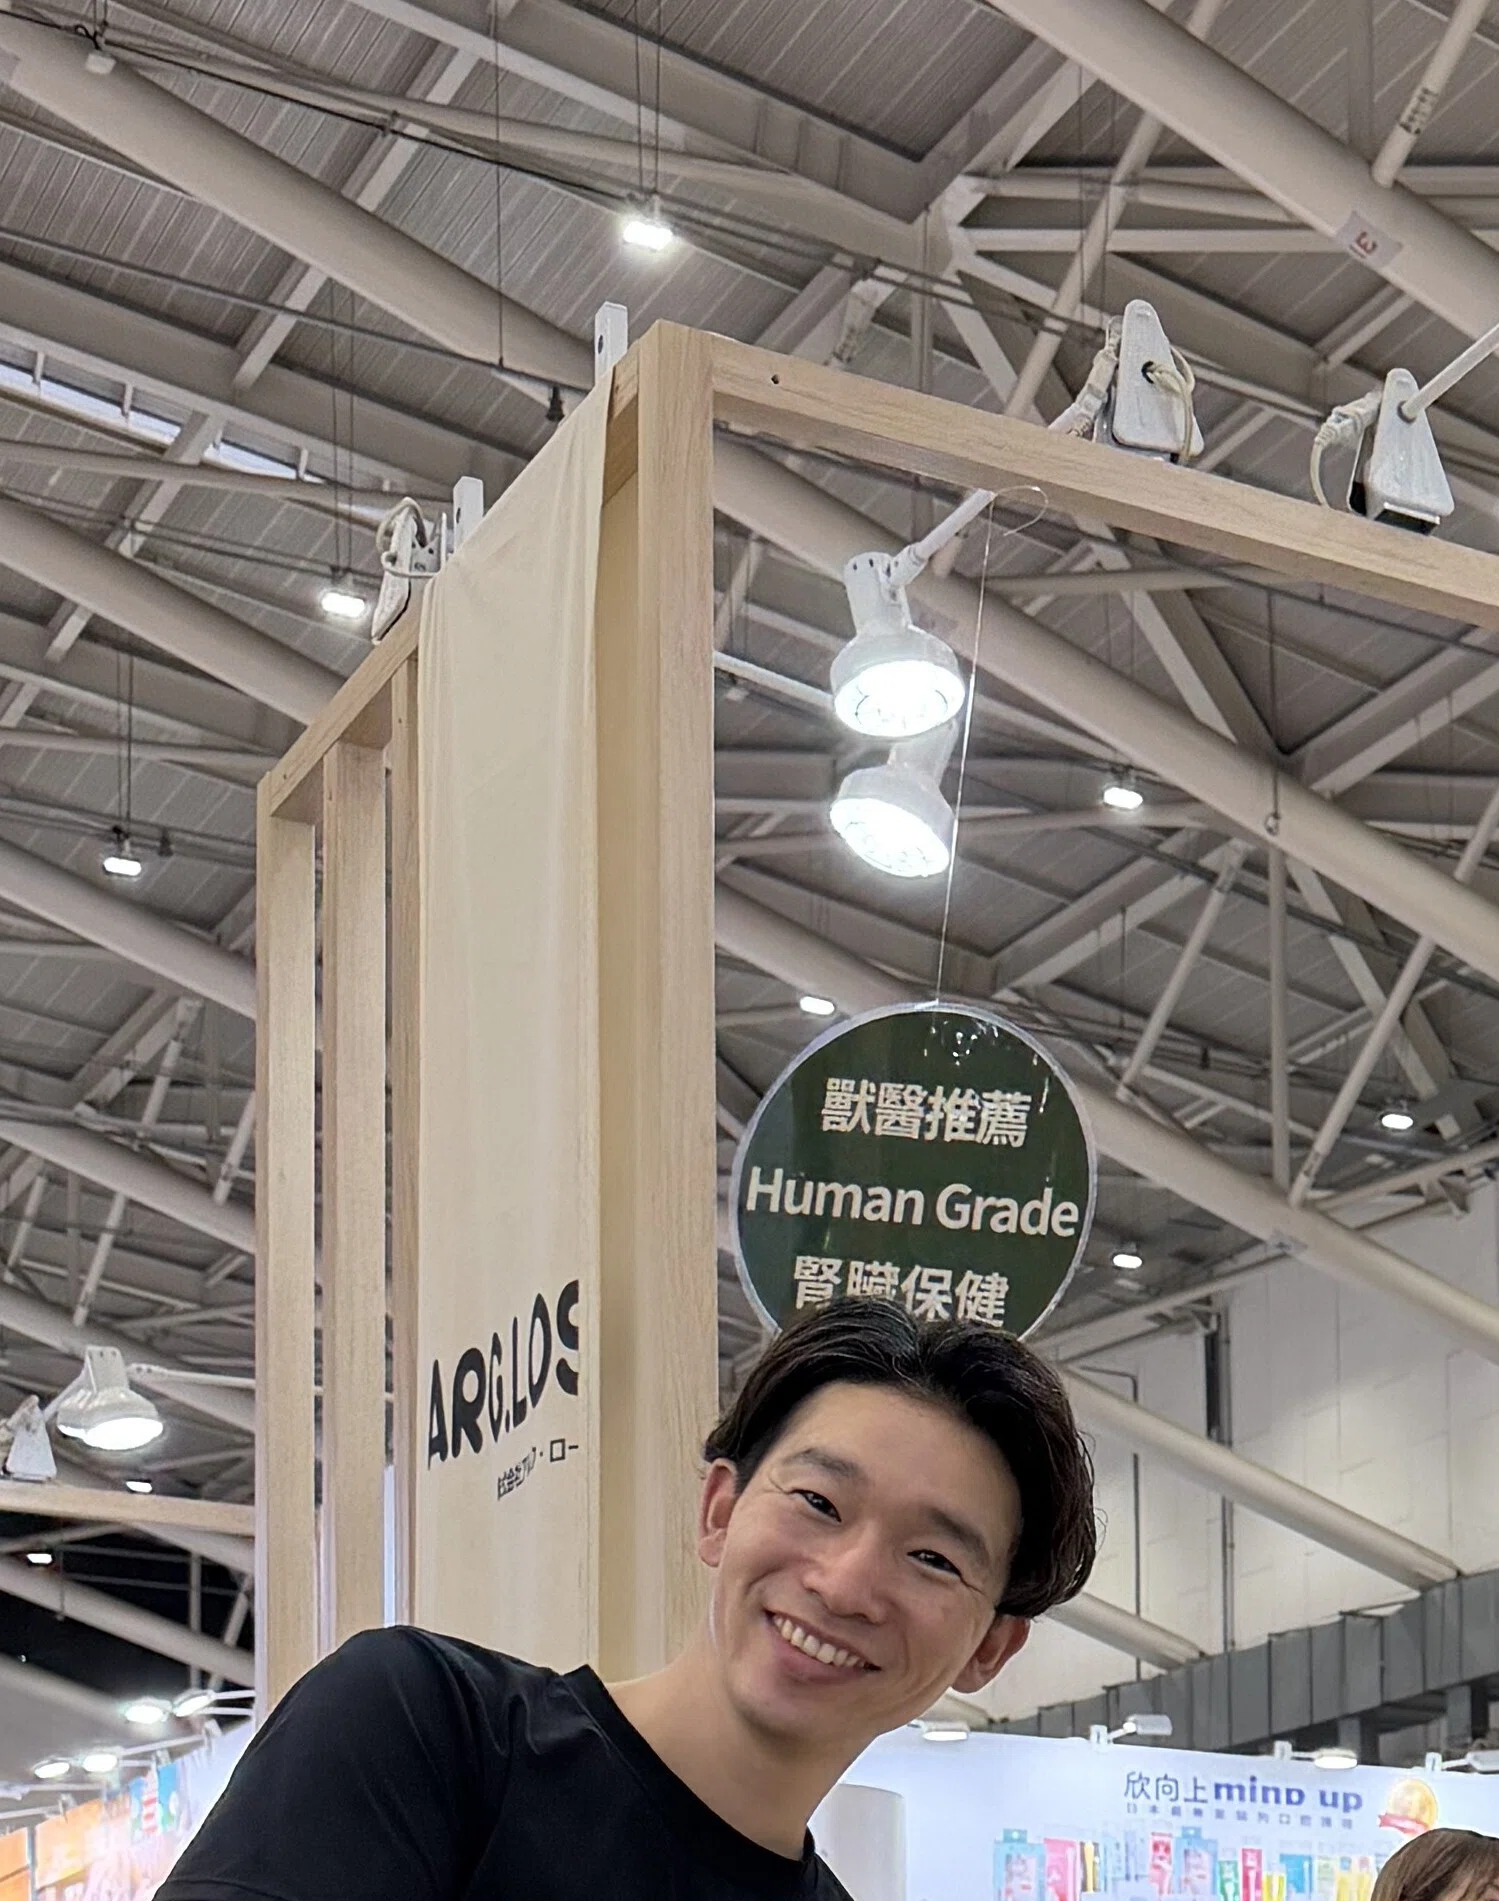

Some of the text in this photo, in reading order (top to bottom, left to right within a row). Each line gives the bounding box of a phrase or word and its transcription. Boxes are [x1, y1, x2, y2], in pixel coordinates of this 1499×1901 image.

[821, 1077, 1032, 1148] 獸醫推薦
[746, 1167, 1079, 1238] Human Grade
[1124, 1771, 1208, 1804] 欣向上
[1319, 1790, 1363, 1814] up
